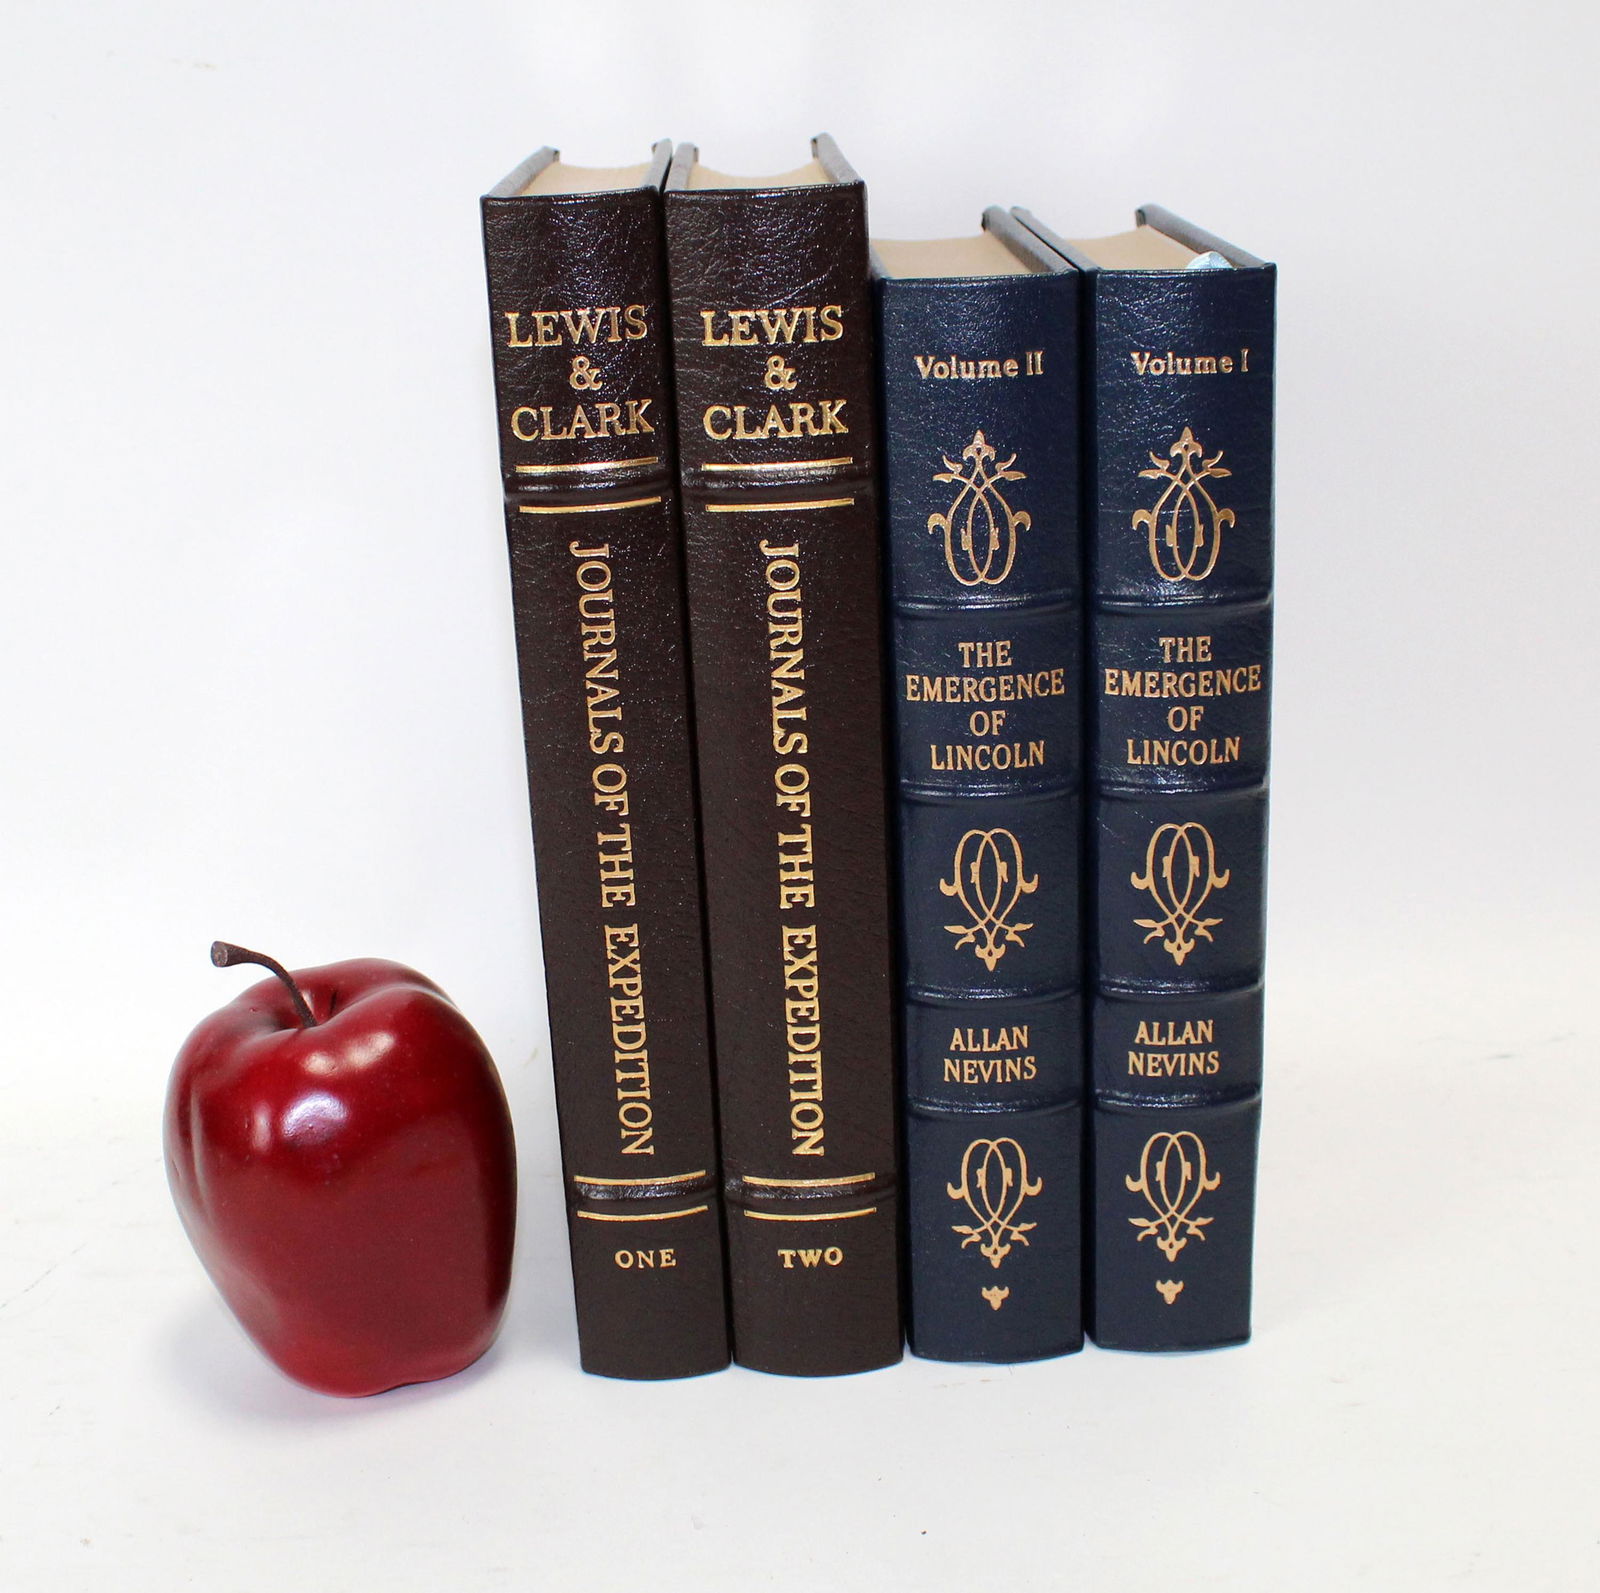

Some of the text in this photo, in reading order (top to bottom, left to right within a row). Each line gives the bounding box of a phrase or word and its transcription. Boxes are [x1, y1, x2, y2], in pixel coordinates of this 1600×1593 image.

[505, 304, 648, 348] LEWIS
[699, 304, 844, 346] LEWIS
[569, 354, 604, 390] &
[763, 354, 798, 390] &
[915, 350, 1044, 380] Volume II
[1130, 348, 1250, 375] Volume I
[510, 398, 655, 441] CLARK
[702, 398, 849, 440] CLARK
[958, 639, 1013, 668] THE
[1160, 635, 1212, 663] THE
[905, 668, 1065, 703] EMERGENCE
[1105, 664, 1262, 698] EMERGENCE
[969, 709, 1006, 737] OF
[1167, 705, 1205, 732] OF
[930, 740, 1045, 771] LINCOLN
[1127, 736, 1241, 766] LINCOLN
[591, 399, 850, 1156] JOURNALS OF THE EXPEDITION
[758, 538, 825, 1157] JOURNALS OF THE EXPEDITION
[949, 1025, 1029, 1053] ALLAN
[1135, 1019, 1214, 1046] ALLAN
[943, 1055, 1037, 1084] NEVINS
[1128, 1050, 1220, 1077] NEVINS
[614, 1248, 677, 1269] ONE
[777, 1247, 844, 1269] TWO
